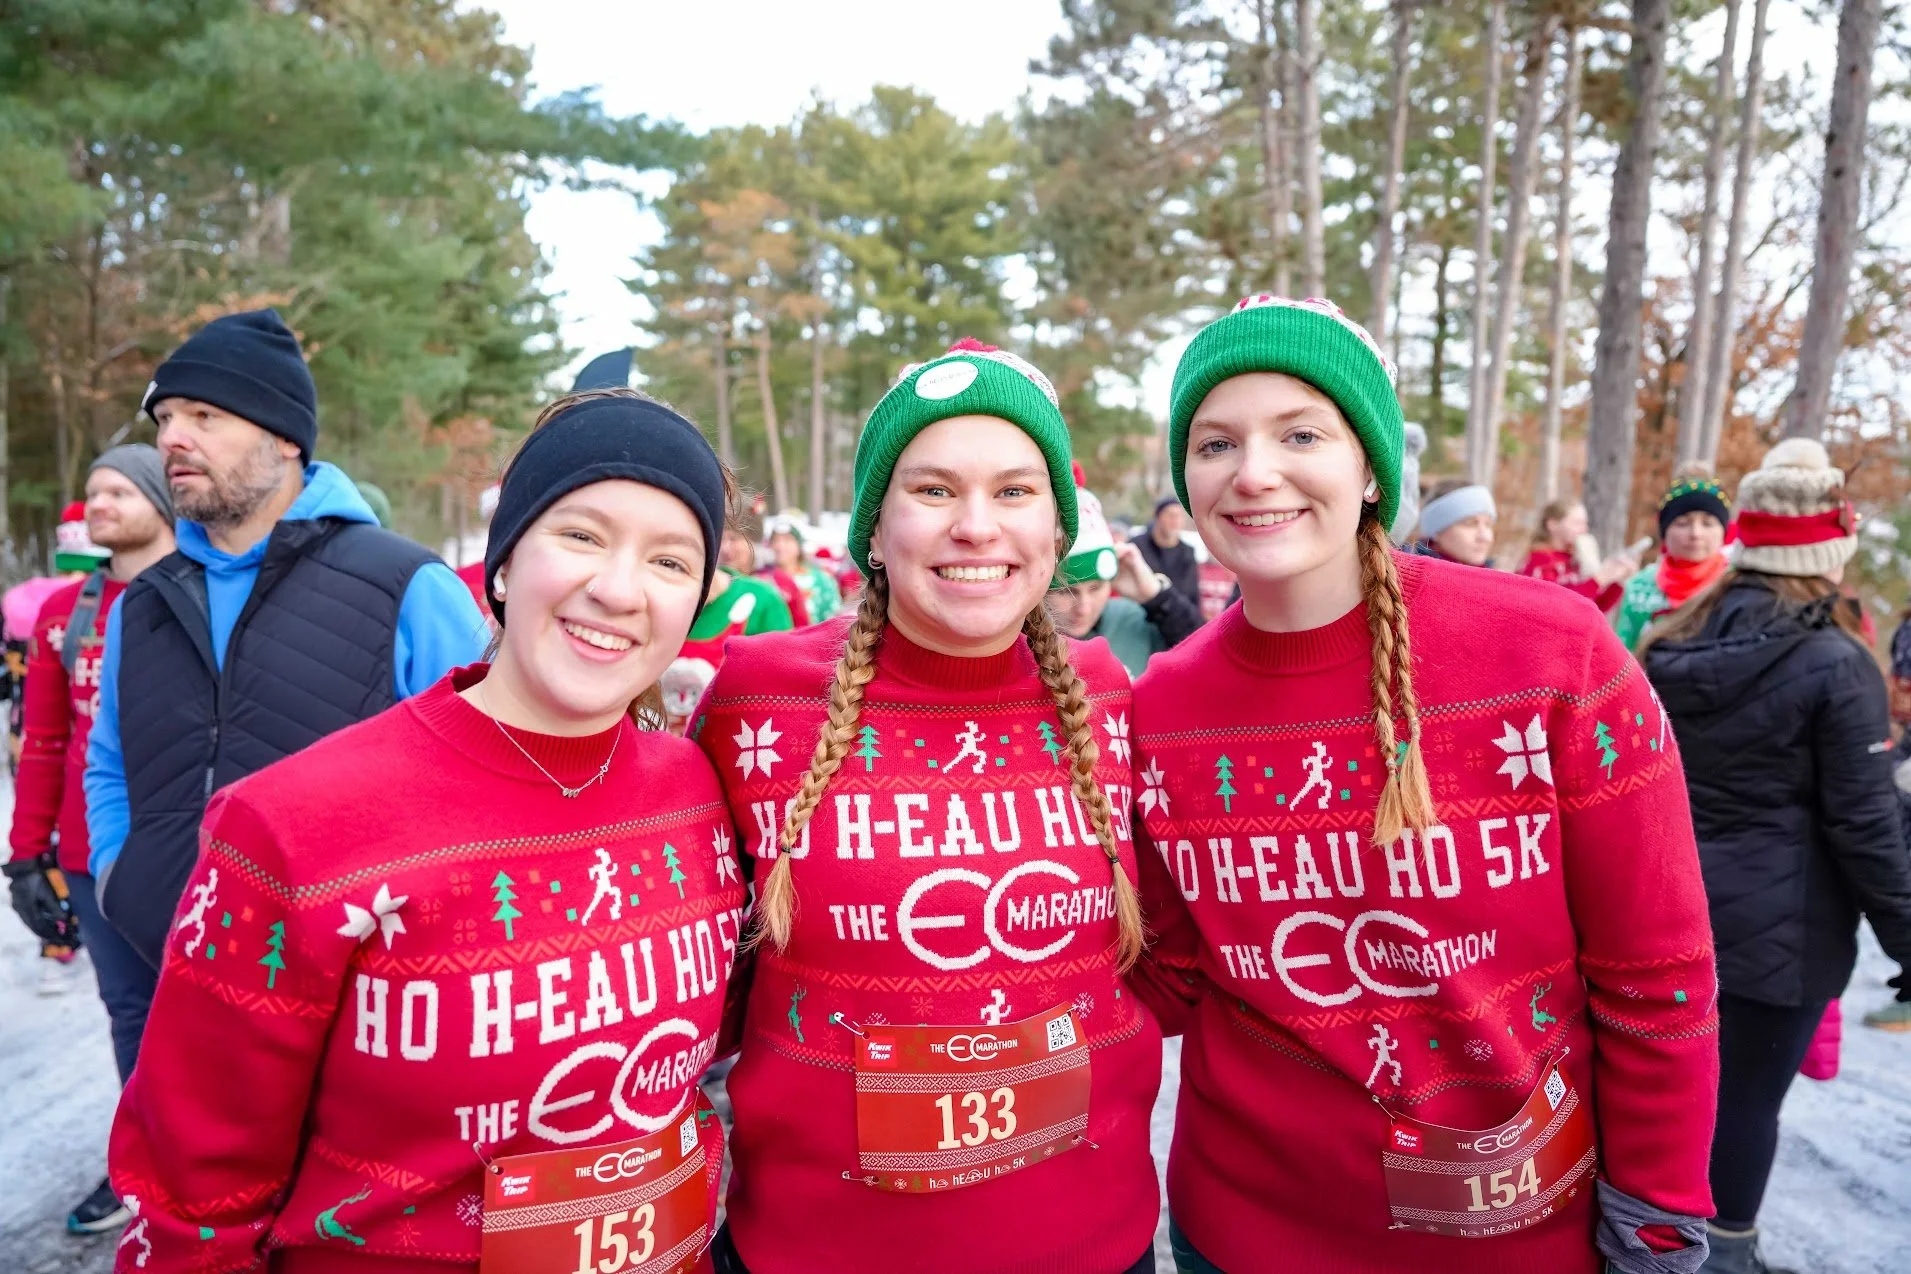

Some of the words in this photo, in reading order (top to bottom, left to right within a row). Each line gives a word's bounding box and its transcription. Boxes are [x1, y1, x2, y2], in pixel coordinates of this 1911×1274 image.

[834, 790, 1022, 859] H-EAU
[1208, 831, 1366, 903] H-EAU
[1384, 825, 1462, 899] HO
[1479, 813, 1551, 889] 5K
[828, 904, 890, 942] THE
[1007, 885, 1117, 932] MARATHO
[1219, 944, 1270, 981] THE
[1363, 929, 1497, 978] MARATHON
[355, 973, 439, 1061] HO
[469, 937, 658, 1058] H-EAU
[667, 919, 717, 1004] HO
[930, 1043, 946, 1053] THE
[976, 1039, 1018, 1052] MARATHON
[454, 1099, 520, 1143] THE
[935, 1086, 1017, 1150] 133
[1457, 1142, 1472, 1150] THE
[1502, 1116, 1533, 1143] MARATHON
[575, 1166, 592, 1178] THE
[624, 1147, 662, 1169] MARATHON
[1013, 1156, 1025, 1169] 5K
[1463, 1156, 1542, 1212] 154
[572, 1203, 656, 1274] 153
[1542, 1205, 1554, 1218] 5K
